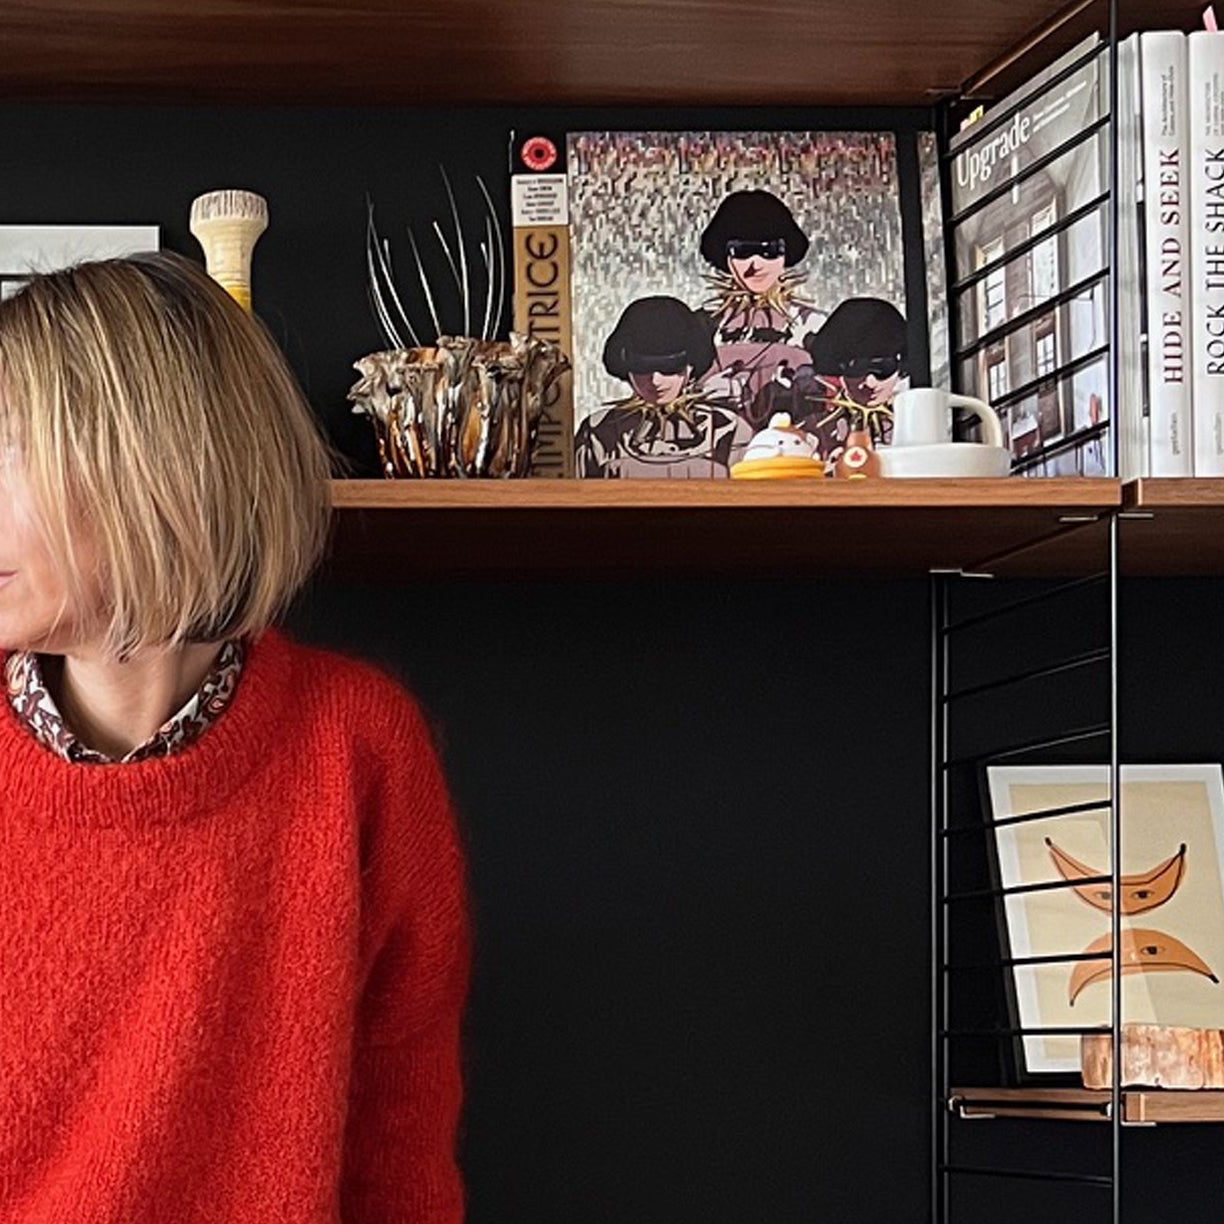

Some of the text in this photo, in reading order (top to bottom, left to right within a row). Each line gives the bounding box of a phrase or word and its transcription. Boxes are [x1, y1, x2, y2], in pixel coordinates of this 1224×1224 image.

[957, 112, 1031, 191] Upgrade
[1160, 147, 1183, 384] HIDE AND SEEK
[1205, 148, 1224, 376] ROCK THE SHACK
